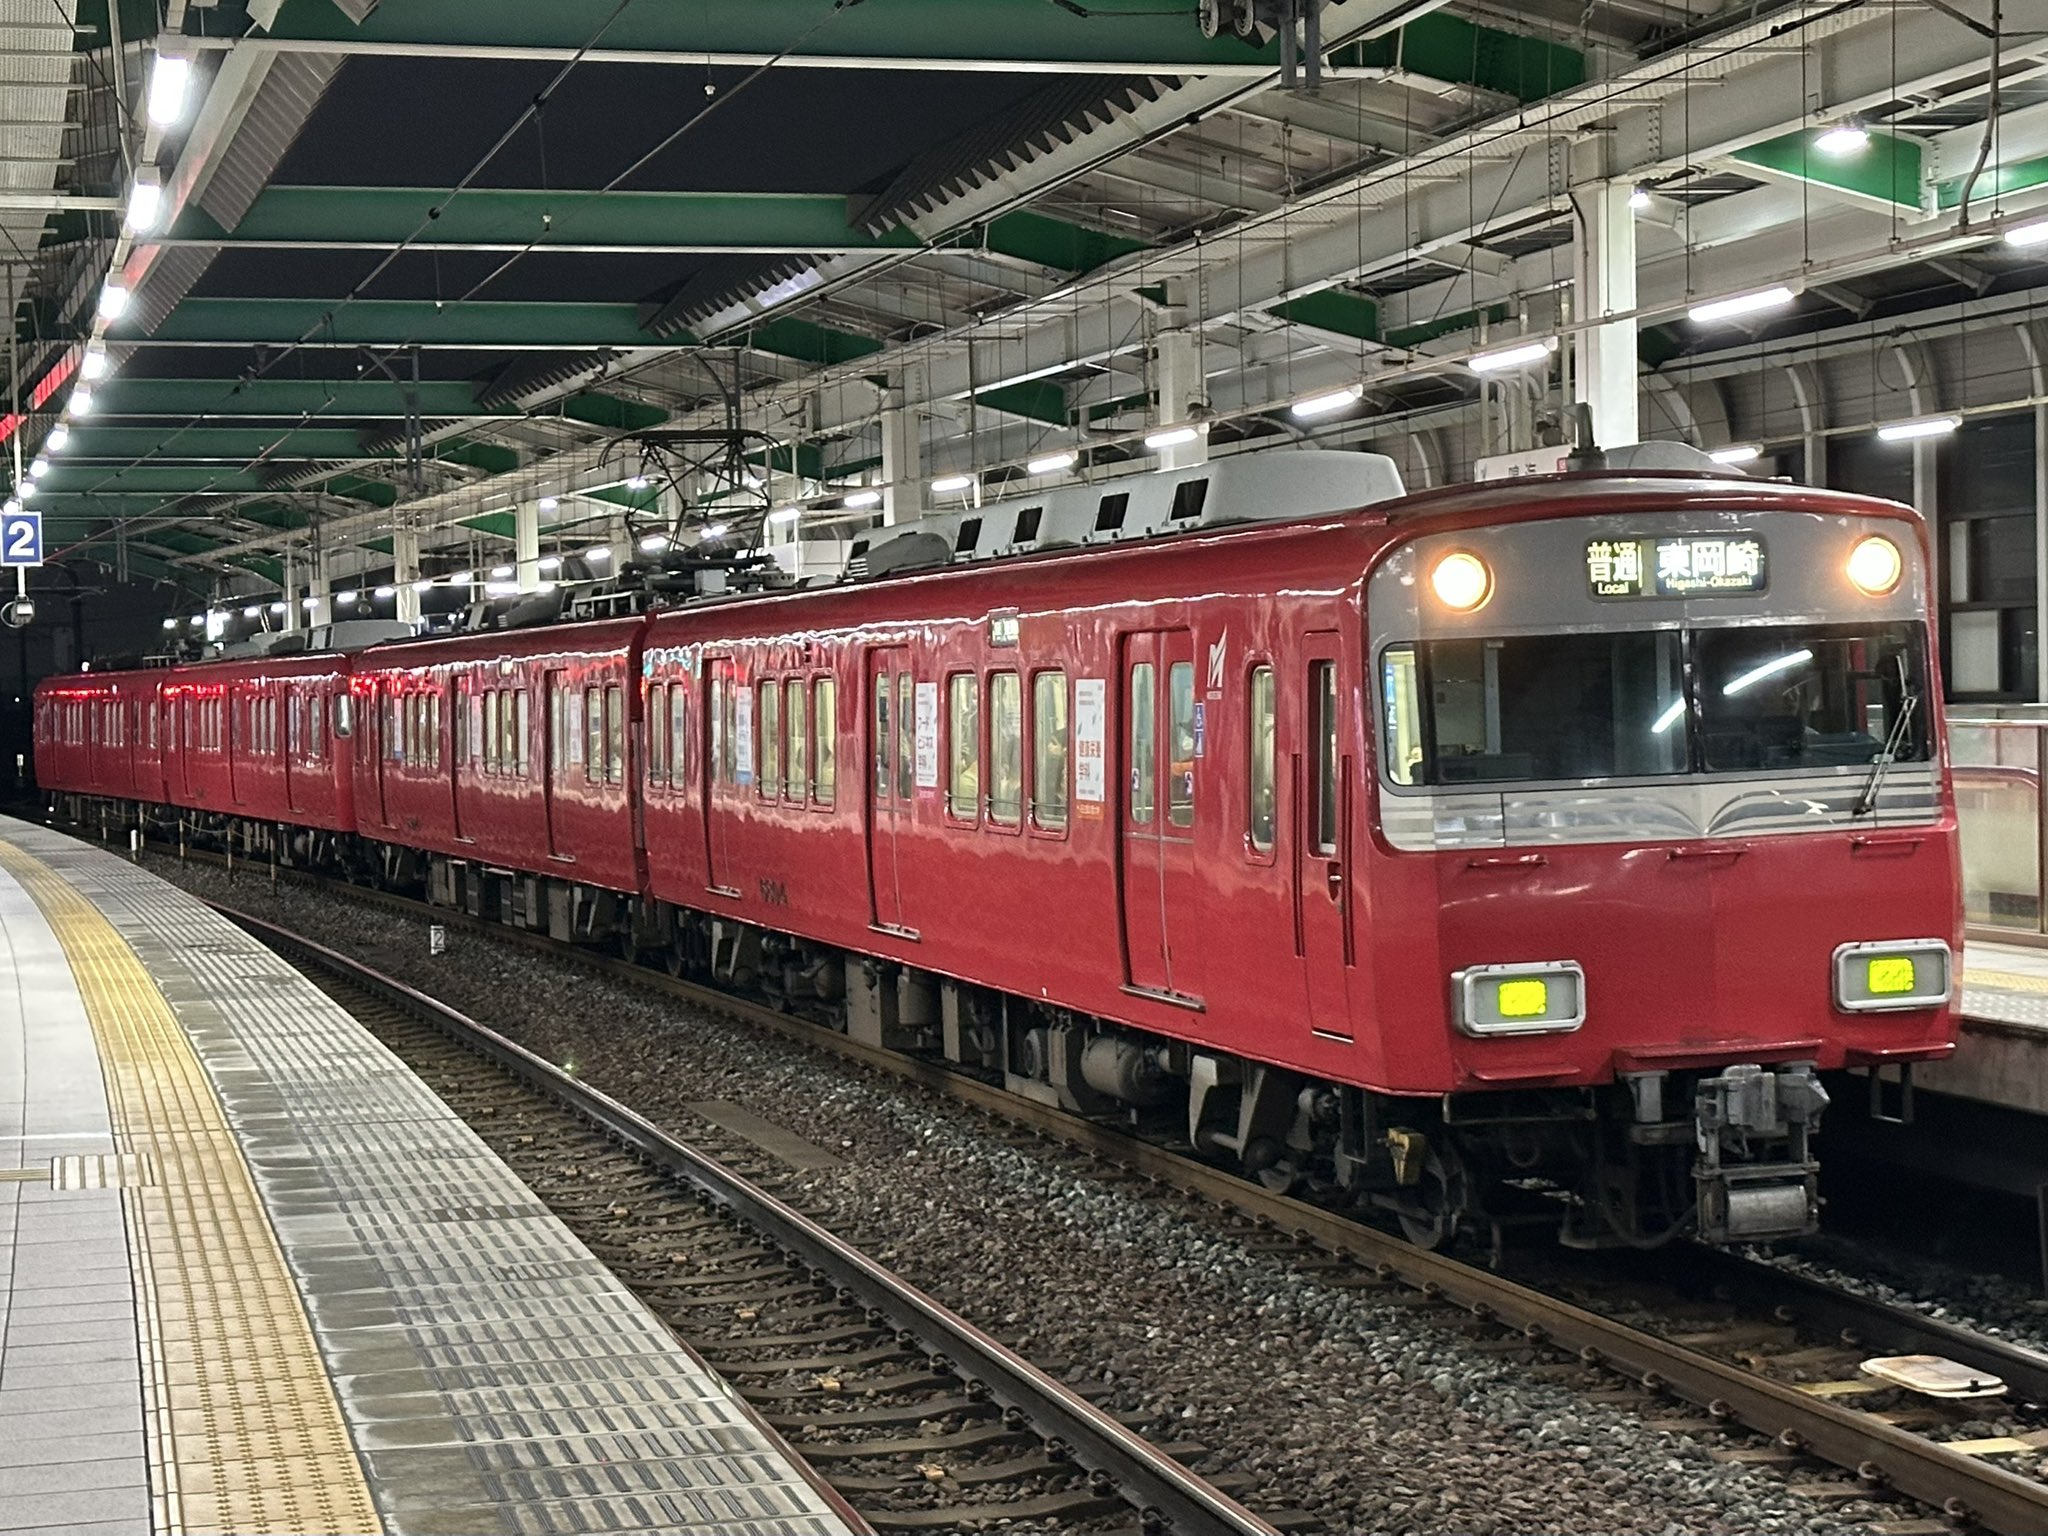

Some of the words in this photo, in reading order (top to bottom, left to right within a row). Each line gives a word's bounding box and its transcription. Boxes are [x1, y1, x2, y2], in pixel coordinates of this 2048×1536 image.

[8, 520, 35, 557] 2
[1587, 541, 1638, 582] 普通
[1657, 538, 1760, 578] 東岡崎
[1598, 582, 1629, 594] Local
